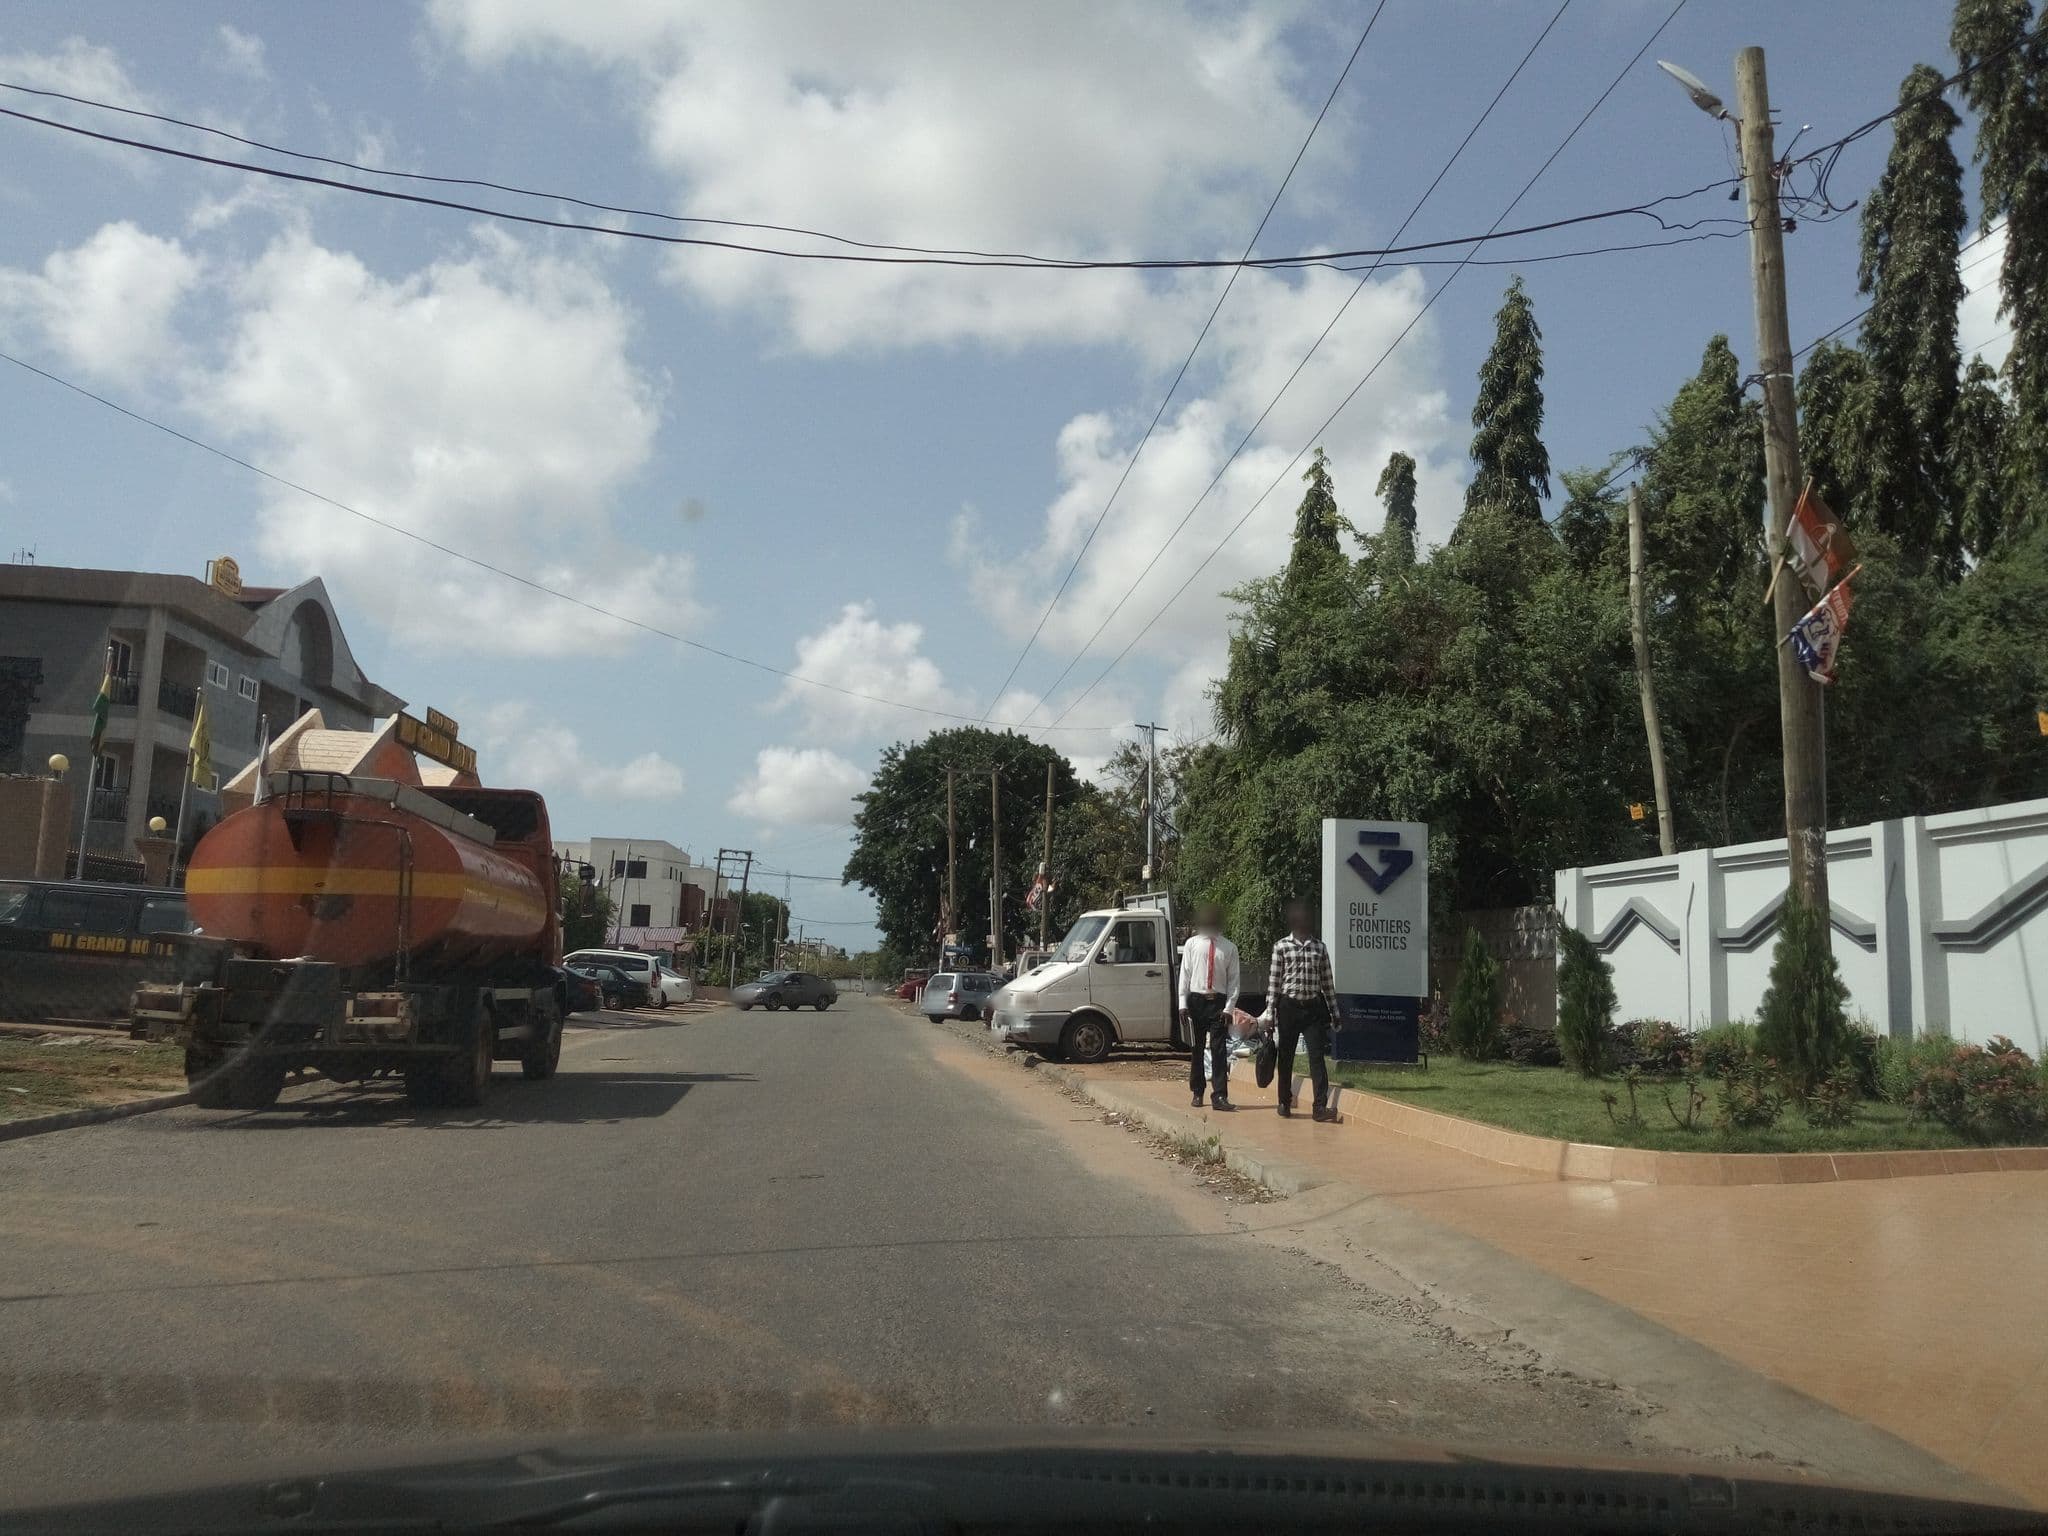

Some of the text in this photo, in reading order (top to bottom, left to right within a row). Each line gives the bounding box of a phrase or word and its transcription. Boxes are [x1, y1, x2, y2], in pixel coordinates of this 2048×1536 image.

[1349, 902, 1378, 916] GULF
[1349, 919, 1411, 934] FRONTIERS
[76, 936, 126, 952] GRAND
[131, 939, 173, 956] HOL
[1349, 934, 1407, 950] LOGISTICS
